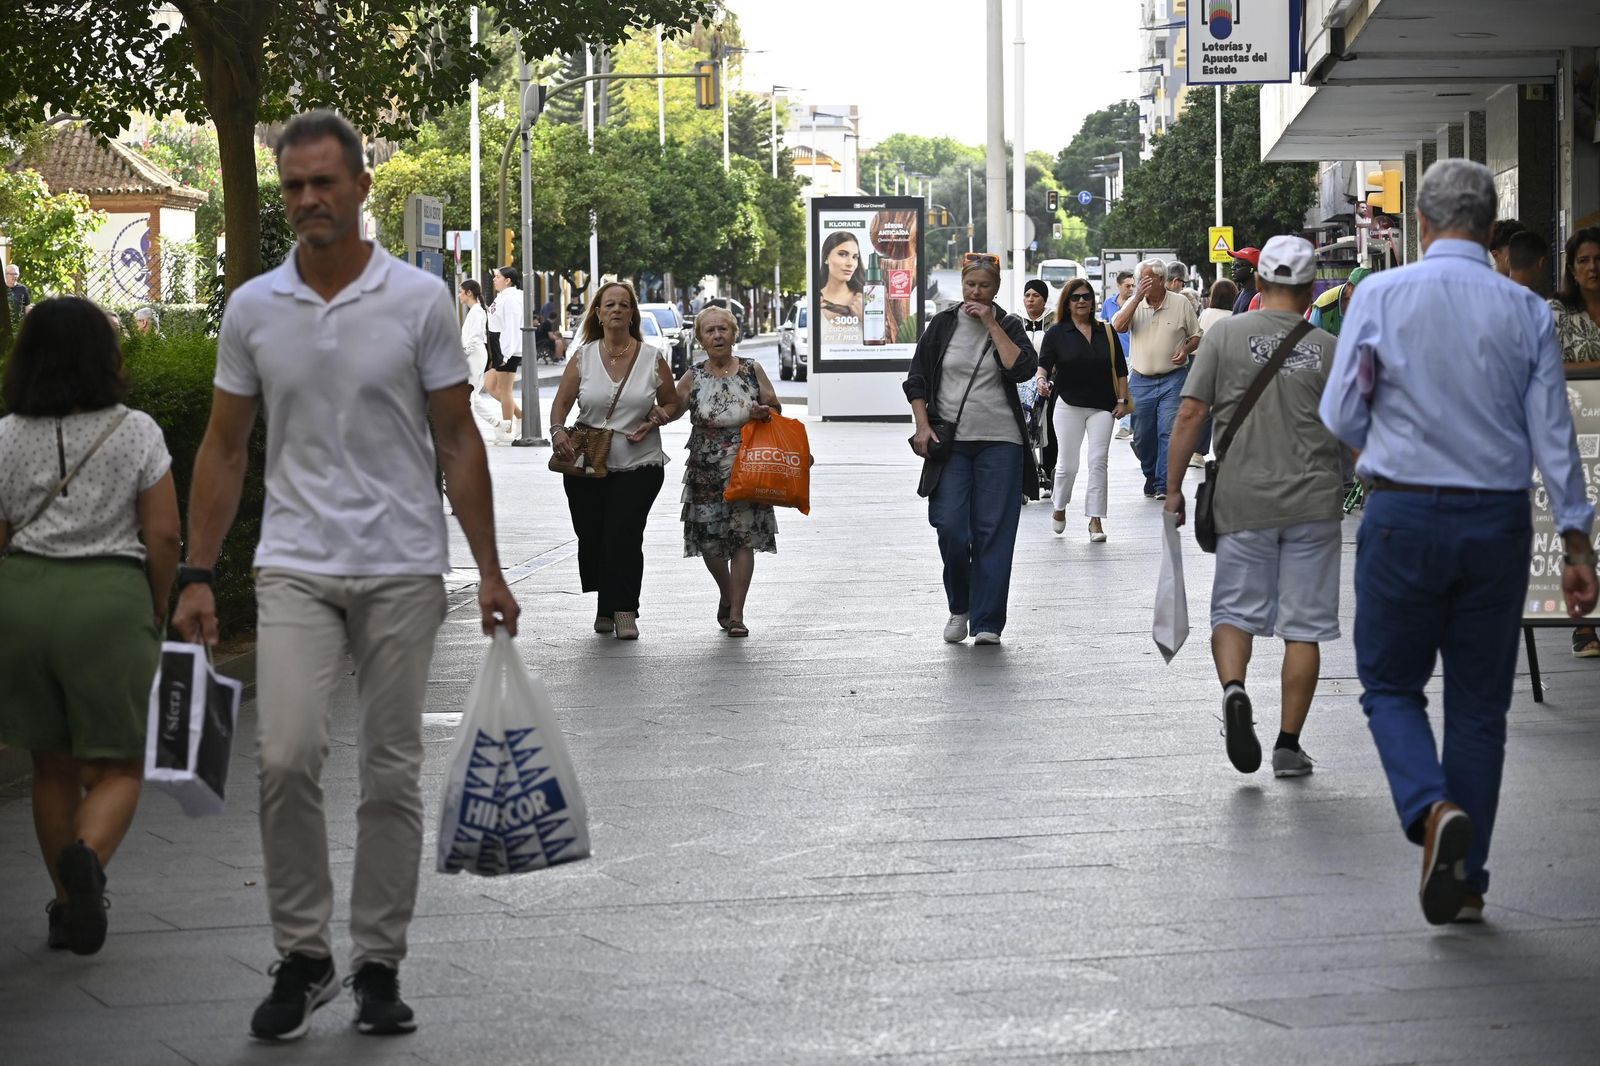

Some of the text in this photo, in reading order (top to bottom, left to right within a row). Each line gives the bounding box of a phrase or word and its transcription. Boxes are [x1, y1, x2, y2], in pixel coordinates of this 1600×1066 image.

[1202, 42, 1252, 53] Loterías y
[1203, 53, 1268, 64] Apuestas del
[1202, 65, 1237, 74] Estado
[830, 316, 859, 325] +3000
